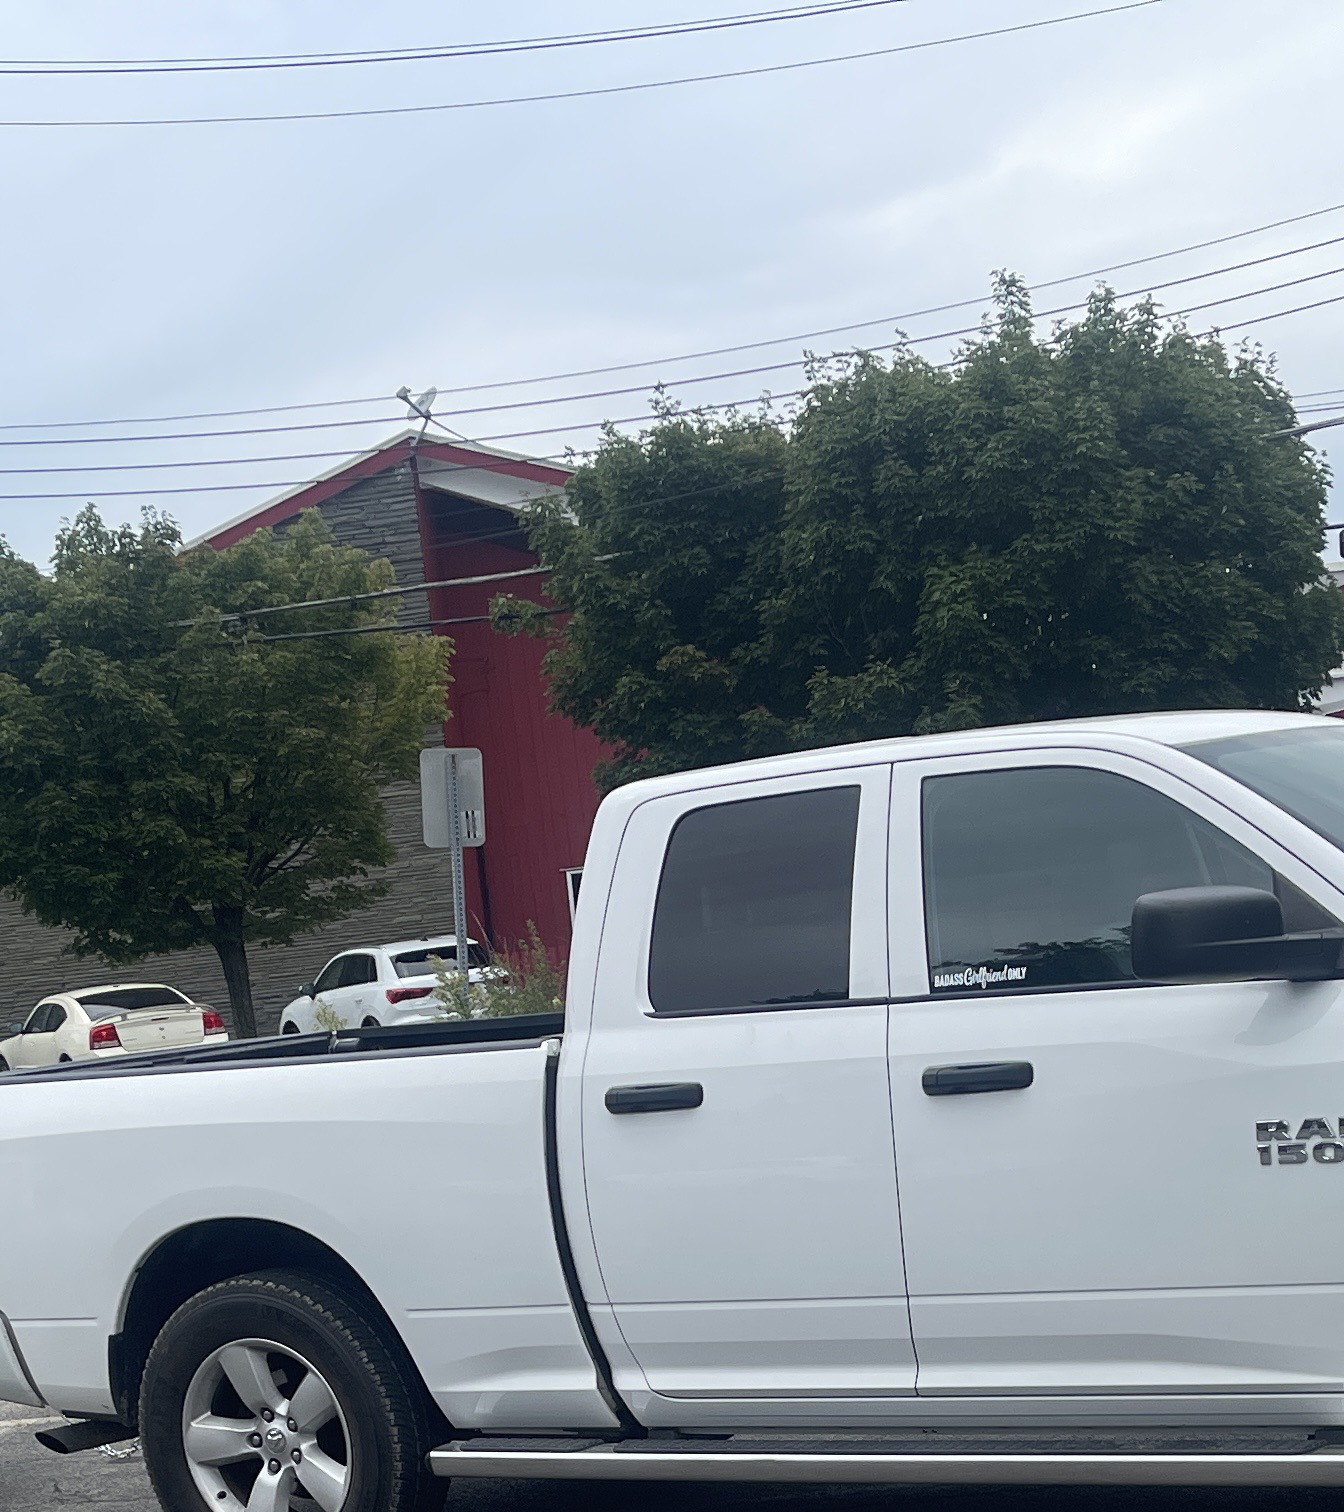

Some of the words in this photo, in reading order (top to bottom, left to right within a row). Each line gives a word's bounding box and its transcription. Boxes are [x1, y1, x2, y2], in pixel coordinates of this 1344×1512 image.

[934, 973, 964, 987] BADASS
[964, 964, 1008, 989] Girlfriend
[1008, 967, 1027, 980] ONLY
